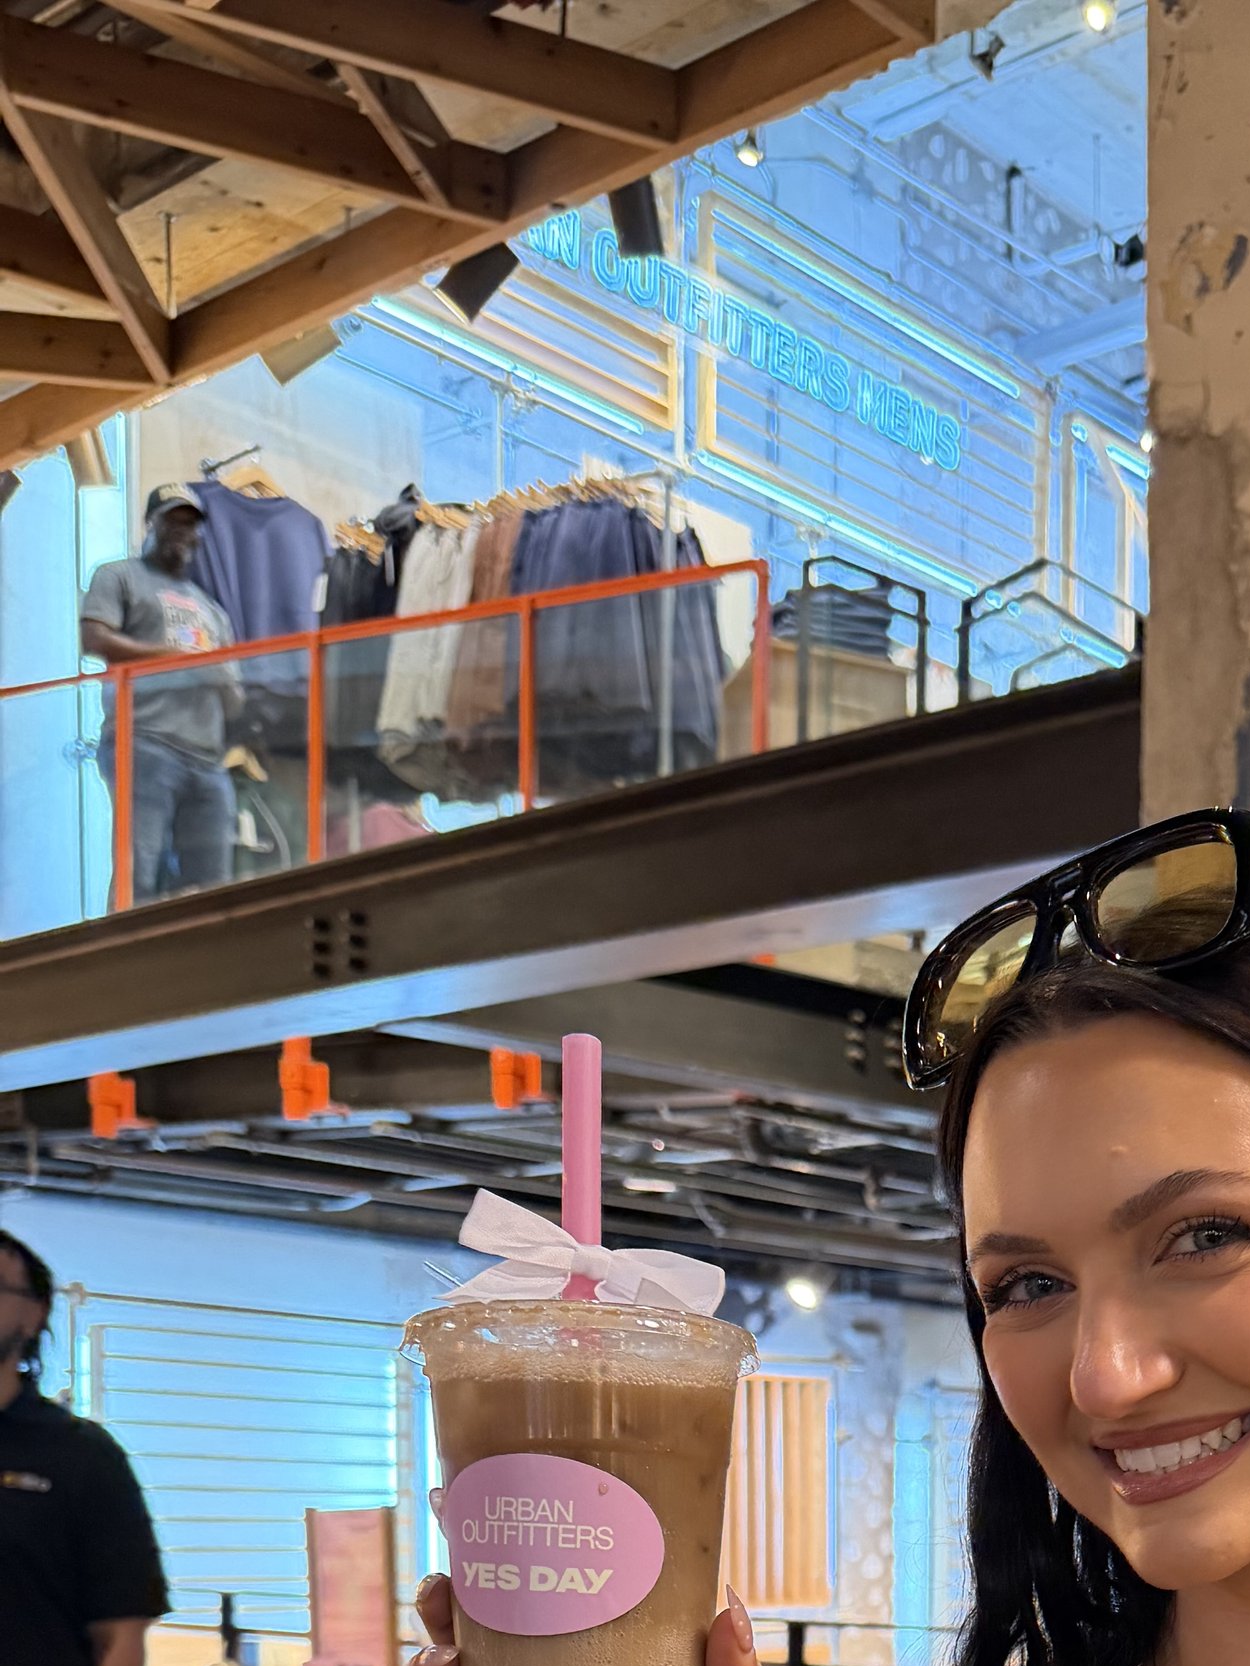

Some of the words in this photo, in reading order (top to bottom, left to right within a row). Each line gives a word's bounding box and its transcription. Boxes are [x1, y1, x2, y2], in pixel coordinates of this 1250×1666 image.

[591, 227, 849, 413] OUTFITTERS
[856, 370, 961, 471] MENS
[484, 1496, 574, 1523] URBAN
[462, 1519, 614, 1550] OUTFITTERS
[462, 1561, 521, 1591] YES
[529, 1565, 614, 1594] DAY
